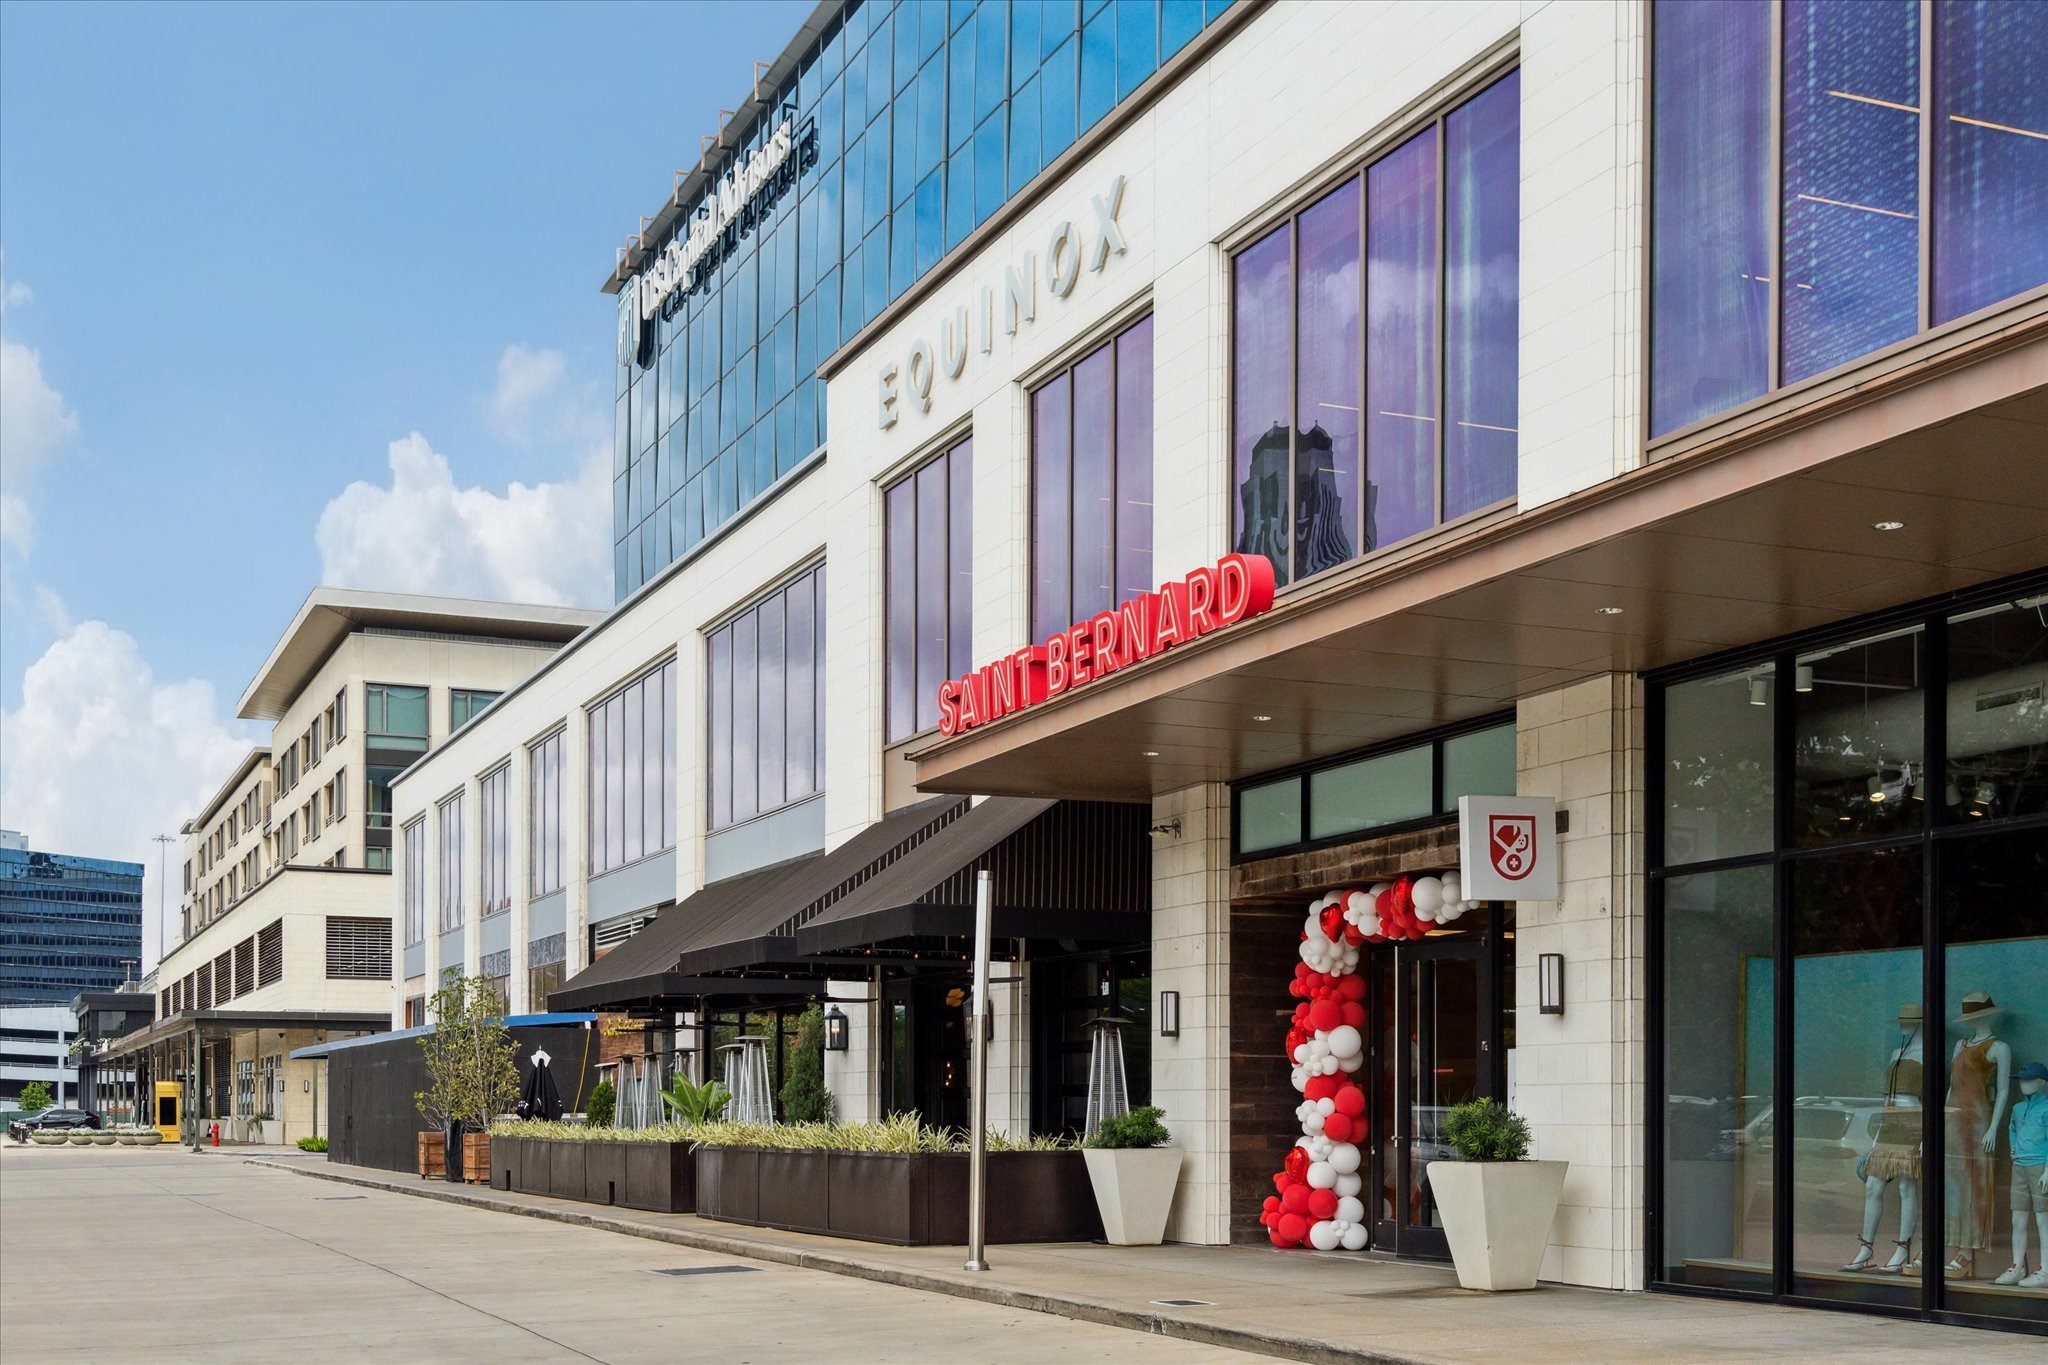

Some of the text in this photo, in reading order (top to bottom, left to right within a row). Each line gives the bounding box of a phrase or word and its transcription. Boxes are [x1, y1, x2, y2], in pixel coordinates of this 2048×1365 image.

[717, 118, 792, 236] Advisors
[878, 174, 1128, 431] EQUINOX
[939, 553, 1271, 738] SAINT BERNARD
